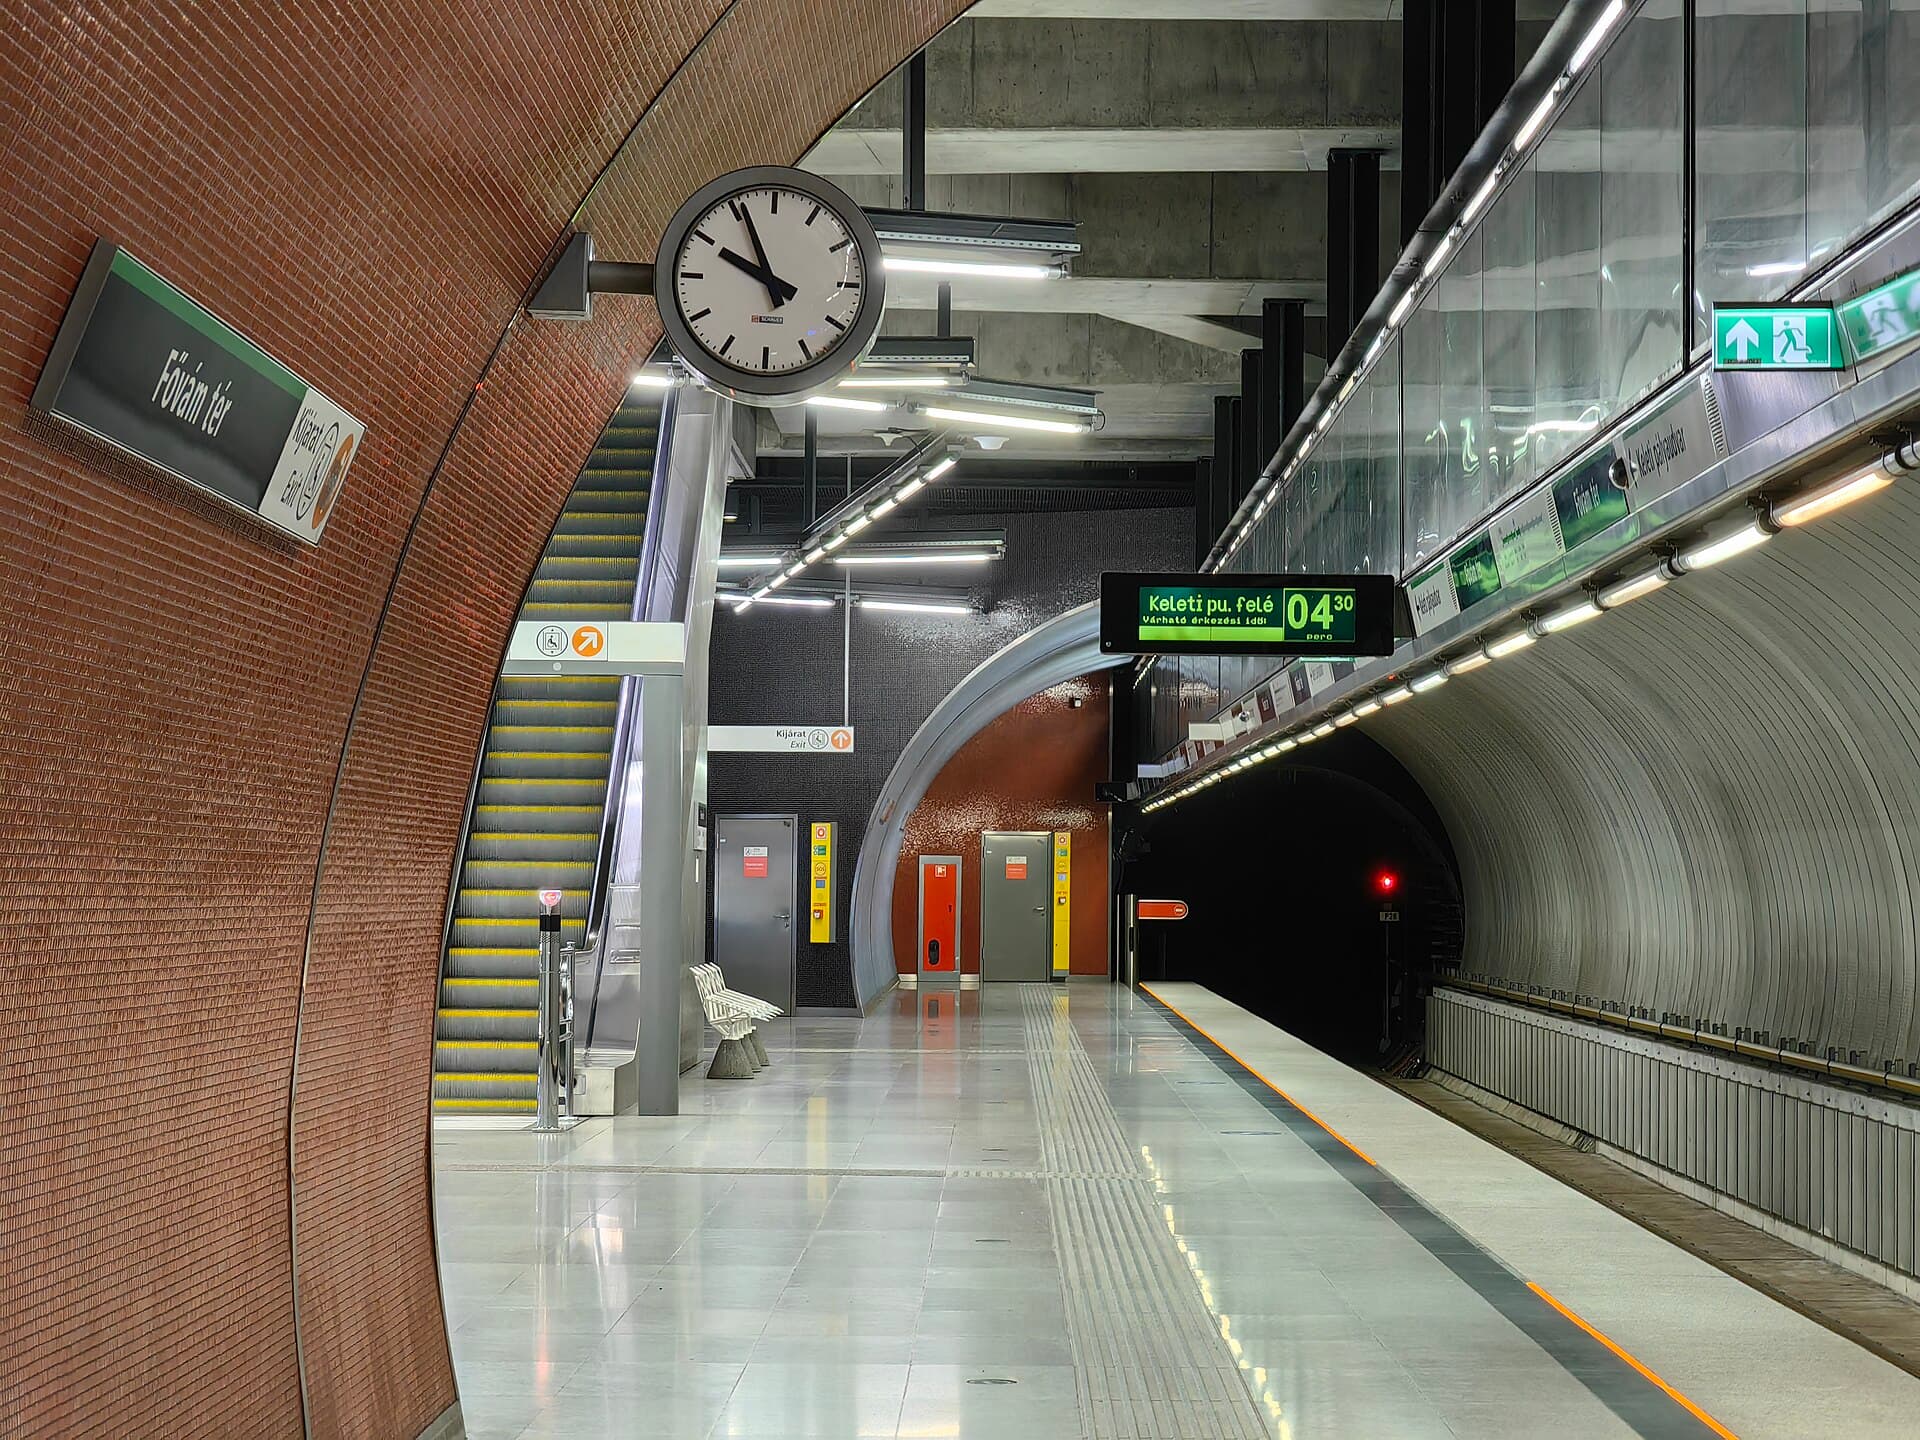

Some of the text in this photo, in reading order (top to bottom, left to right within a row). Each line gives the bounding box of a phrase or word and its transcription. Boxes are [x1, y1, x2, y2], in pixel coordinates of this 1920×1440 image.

[151, 348, 233, 437] Fővám tér
[292, 407, 326, 455] Kijárat
[1635, 423, 1687, 478] Keleti pályaudvar
[280, 470, 304, 508] Exit
[1149, 594, 1274, 616] Keleti pu. felé
[1287, 593, 1334, 630] 04
[1334, 595, 1354, 611] 30
[1142, 615, 1187, 624] Várható
[1191, 616, 1241, 625] érkezési
[776, 729, 807, 739] Kijárat
[790, 741, 806, 749] Exit
